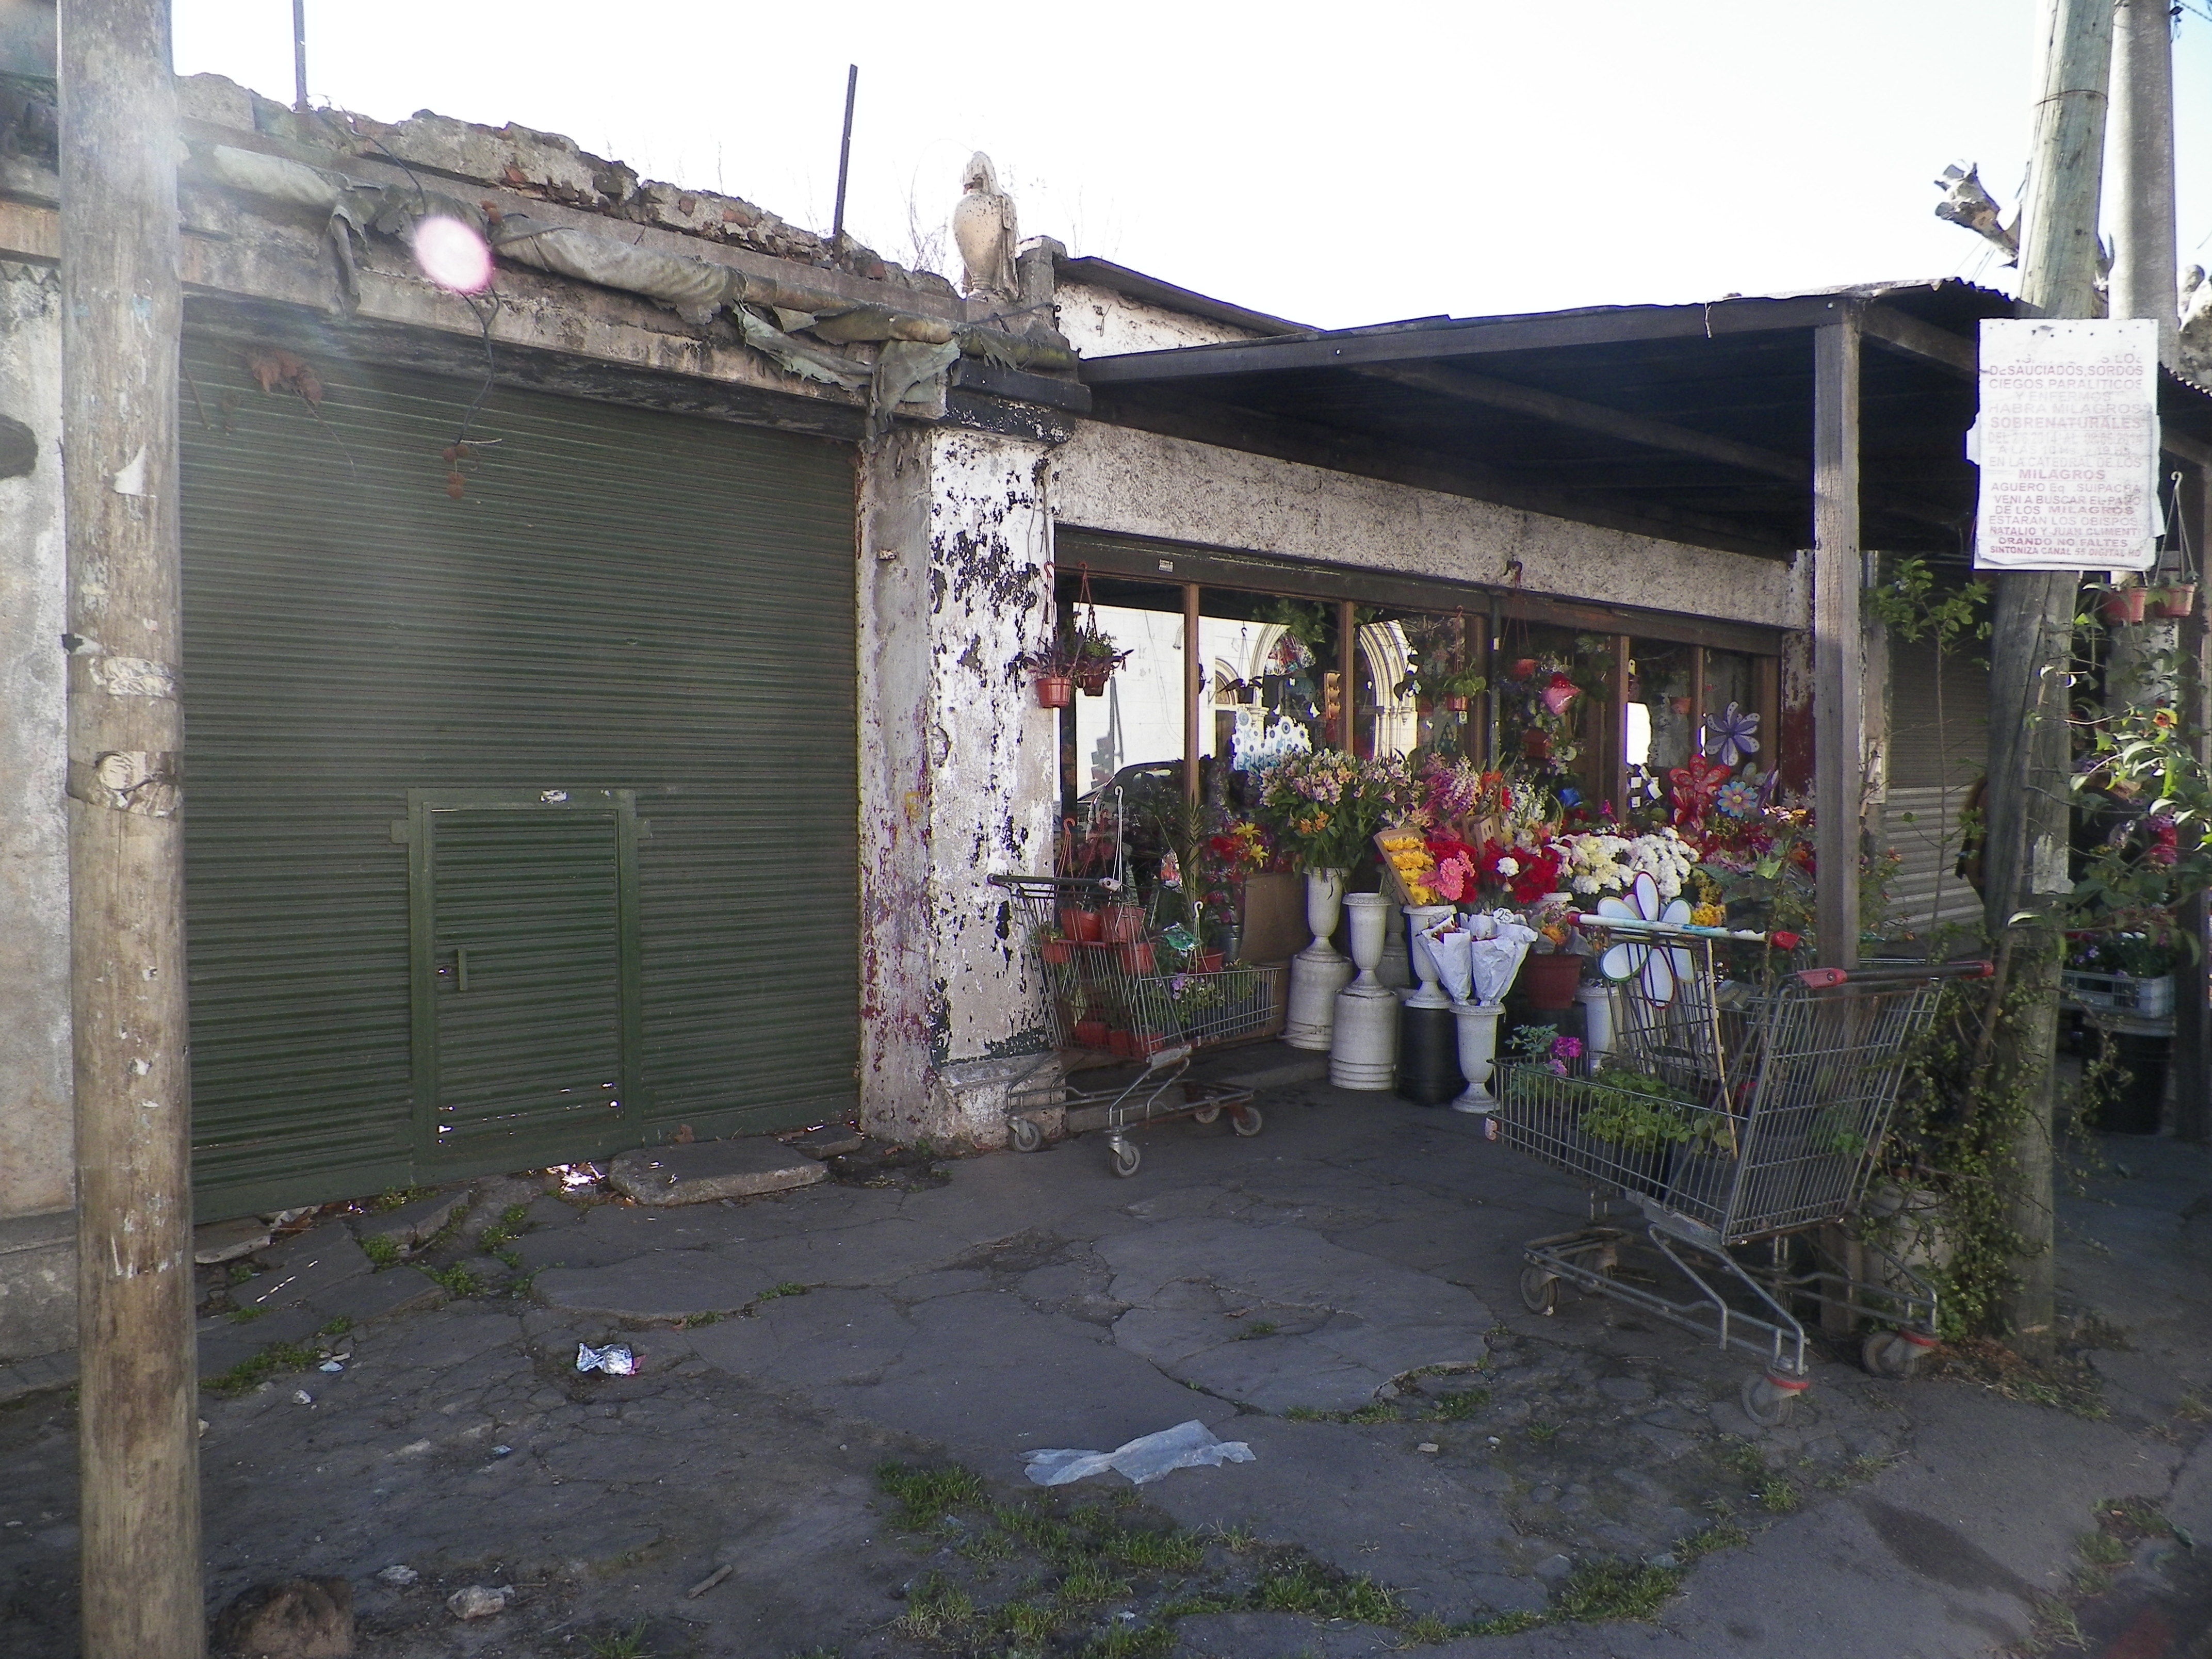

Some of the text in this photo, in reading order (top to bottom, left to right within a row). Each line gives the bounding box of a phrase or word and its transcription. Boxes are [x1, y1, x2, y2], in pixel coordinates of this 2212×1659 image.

[2088, 366, 2143, 376] SORDOS
[2048, 379, 2142, 389] PARALITICOS
[2016, 392, 2111, 401] Y ENFERMOS
[1989, 403, 2142, 414] HABRA MILAGROS
[1991, 417, 2141, 429] SOBRENATURALES
[2011, 446, 2037, 454] LAS
[1990, 457, 2141, 467] EN LA CATEDRAL DE LOS
[2019, 469, 2105, 479] MILAGROS
[1991, 483, 2045, 491] AGUERO
[1995, 495, 2021, 504] VENI
[2037, 496, 2086, 504] BUSCAR
[1996, 506, 2011, 514] DE
[2016, 506, 2040, 514] LOS
[1990, 516, 2047, 525] ESTARAN
[2052, 516, 2076, 525] LOS
[1990, 527, 2036, 535] NATALIO
[2050, 527, 2081, 535] JUAN
[1998, 537, 2052, 545] ORANDO
[2080, 539, 2128, 547] FALTES
[2041, 547, 2071, 555] CANAL
[2089, 548, 2125, 557] DIGITAL
[1497, 909, 1511, 921] 25
